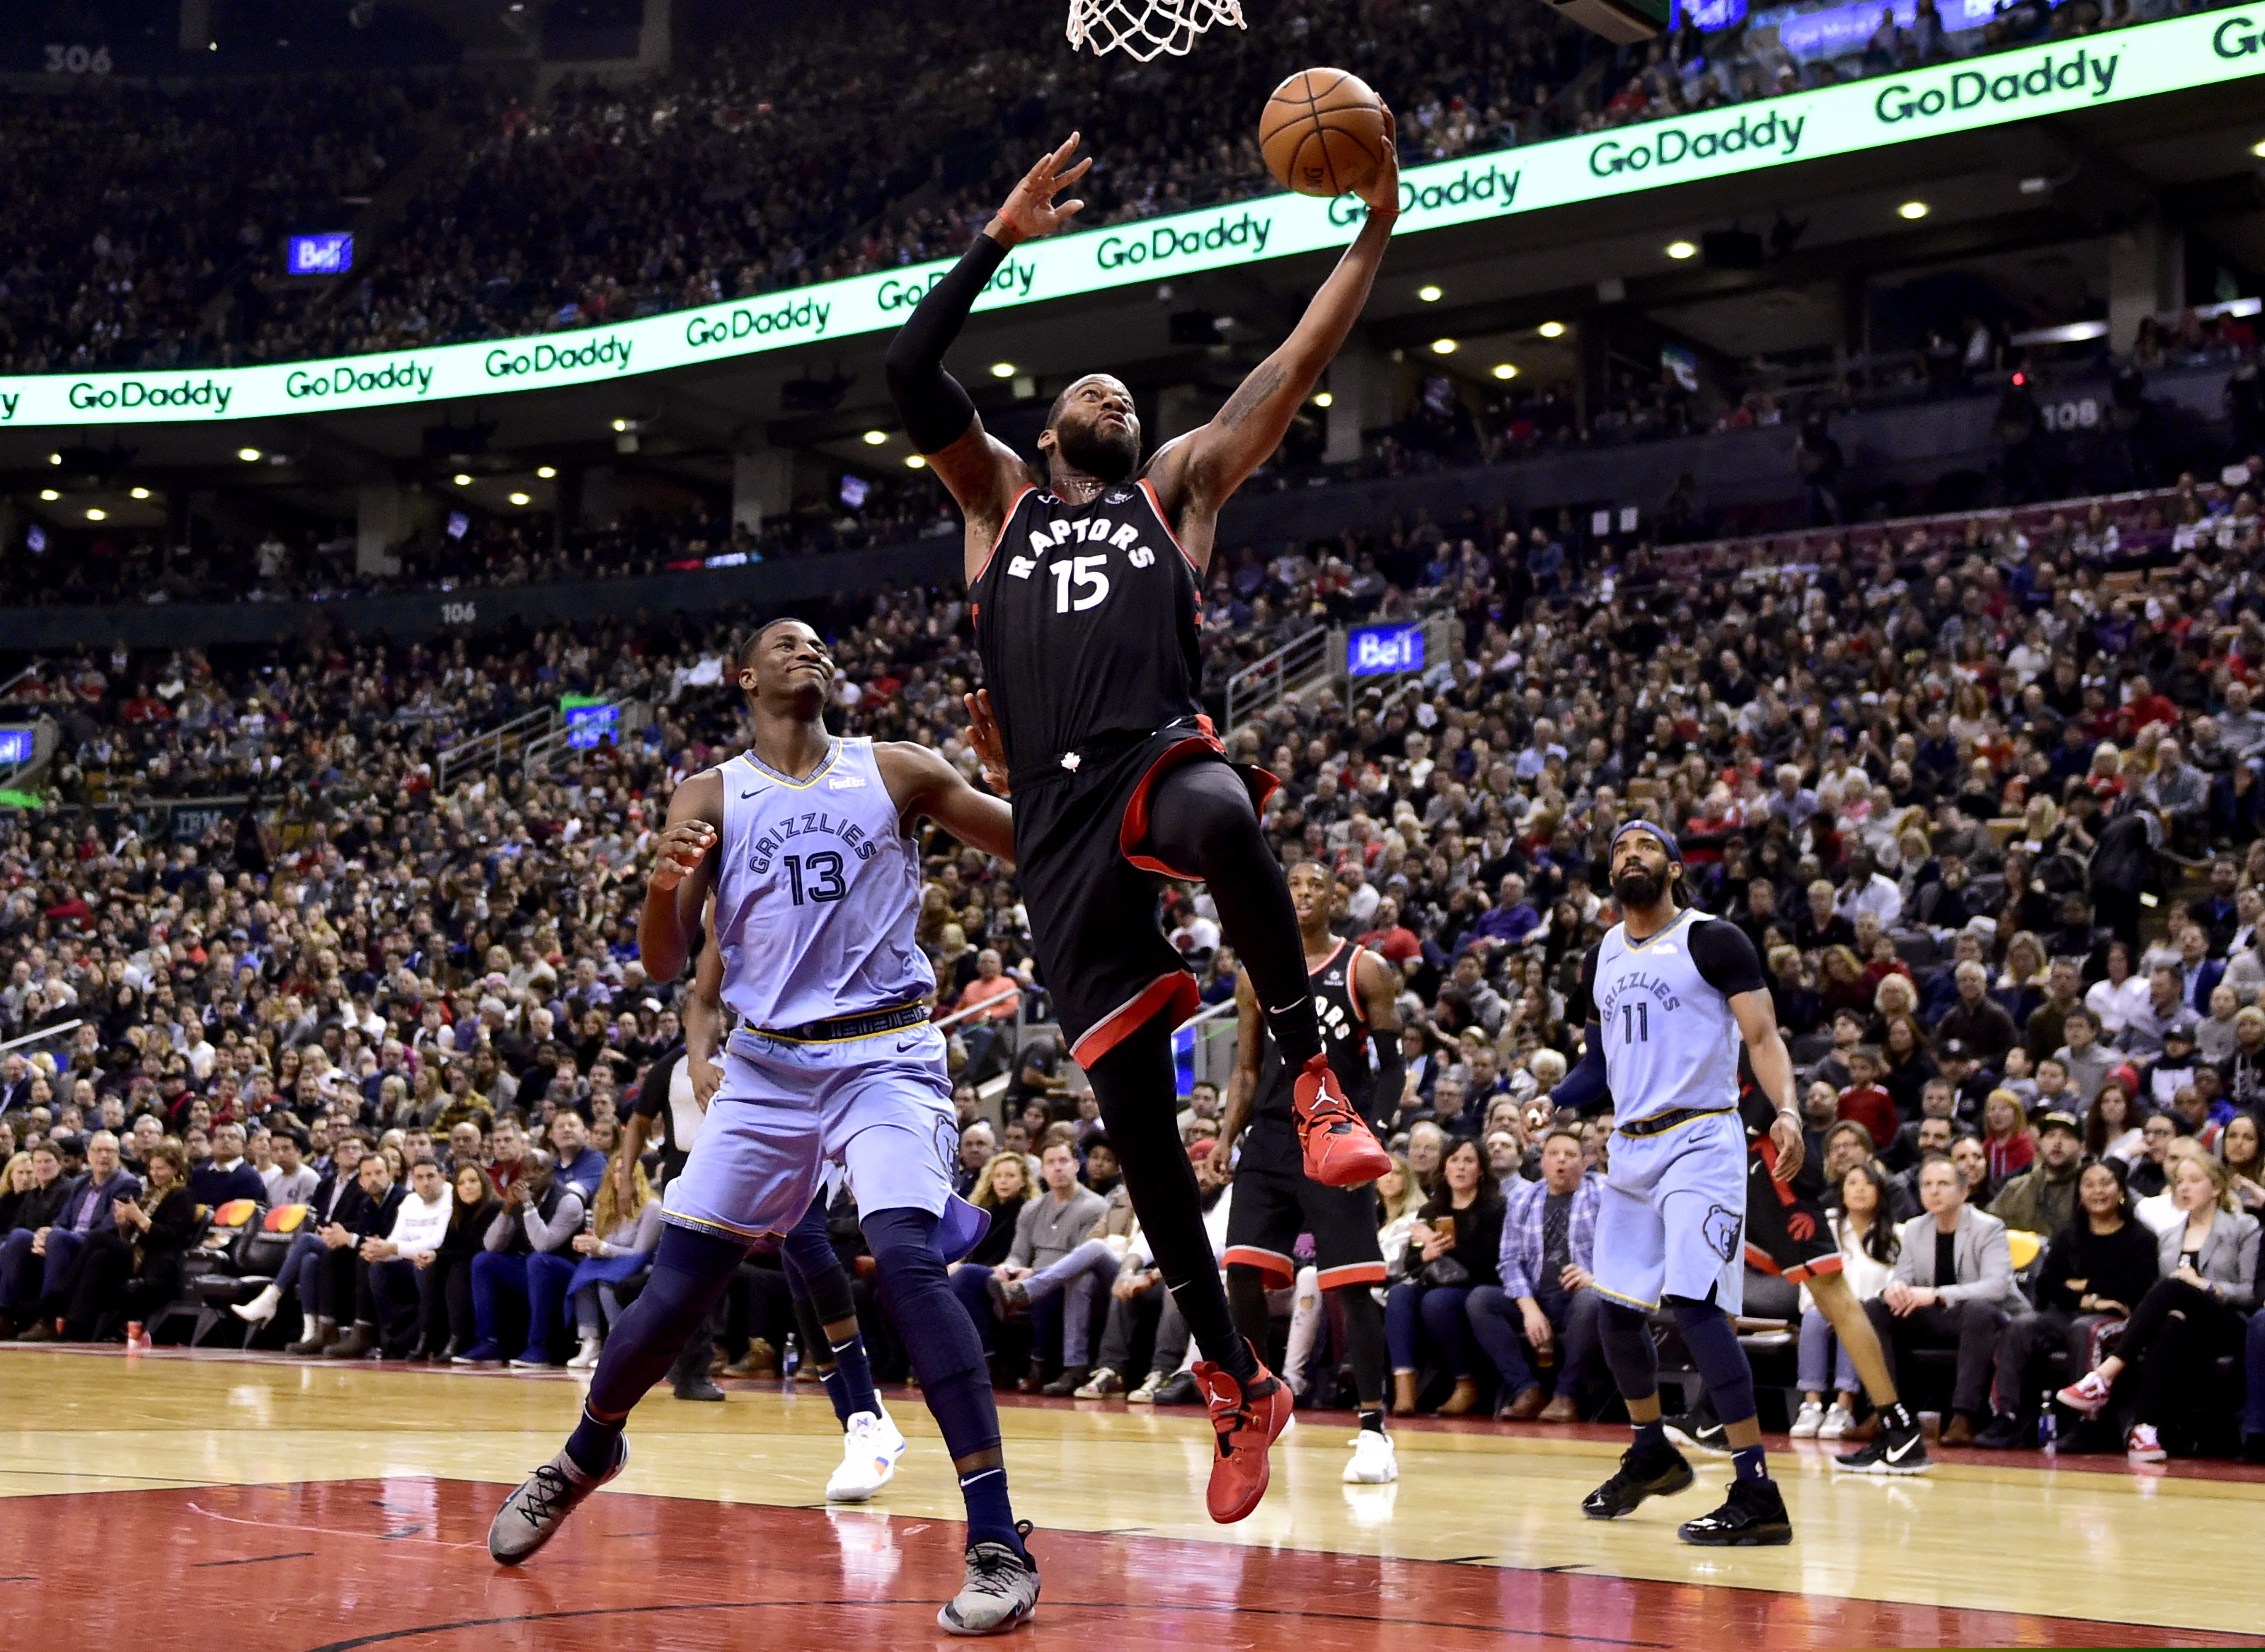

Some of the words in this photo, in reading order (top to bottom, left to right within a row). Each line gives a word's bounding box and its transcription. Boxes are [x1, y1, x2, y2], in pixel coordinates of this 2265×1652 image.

[45, 45, 112, 74] 306
[1876, 50, 2118, 123] GoDaddy
[1590, 111, 1805, 177] GoDaddy
[1097, 212, 1271, 268] GoDaddy
[687, 297, 831, 347] GoDaddy
[287, 361, 433, 398] GoDaddy
[486, 335, 633, 377] GoDaddy
[69, 380, 233, 413] GoDaddy
[2041, 399, 2098, 431] 108
[1007, 517, 1155, 579] RAPTORS
[1049, 553, 1110, 614] 15
[441, 602, 476, 623] 106
[749, 813, 877, 875] GRIZZLIES
[784, 850, 847, 906] 13
[1602, 972, 1680, 1022] GRIZZLIES
[1622, 1002, 1648, 1044] 11
